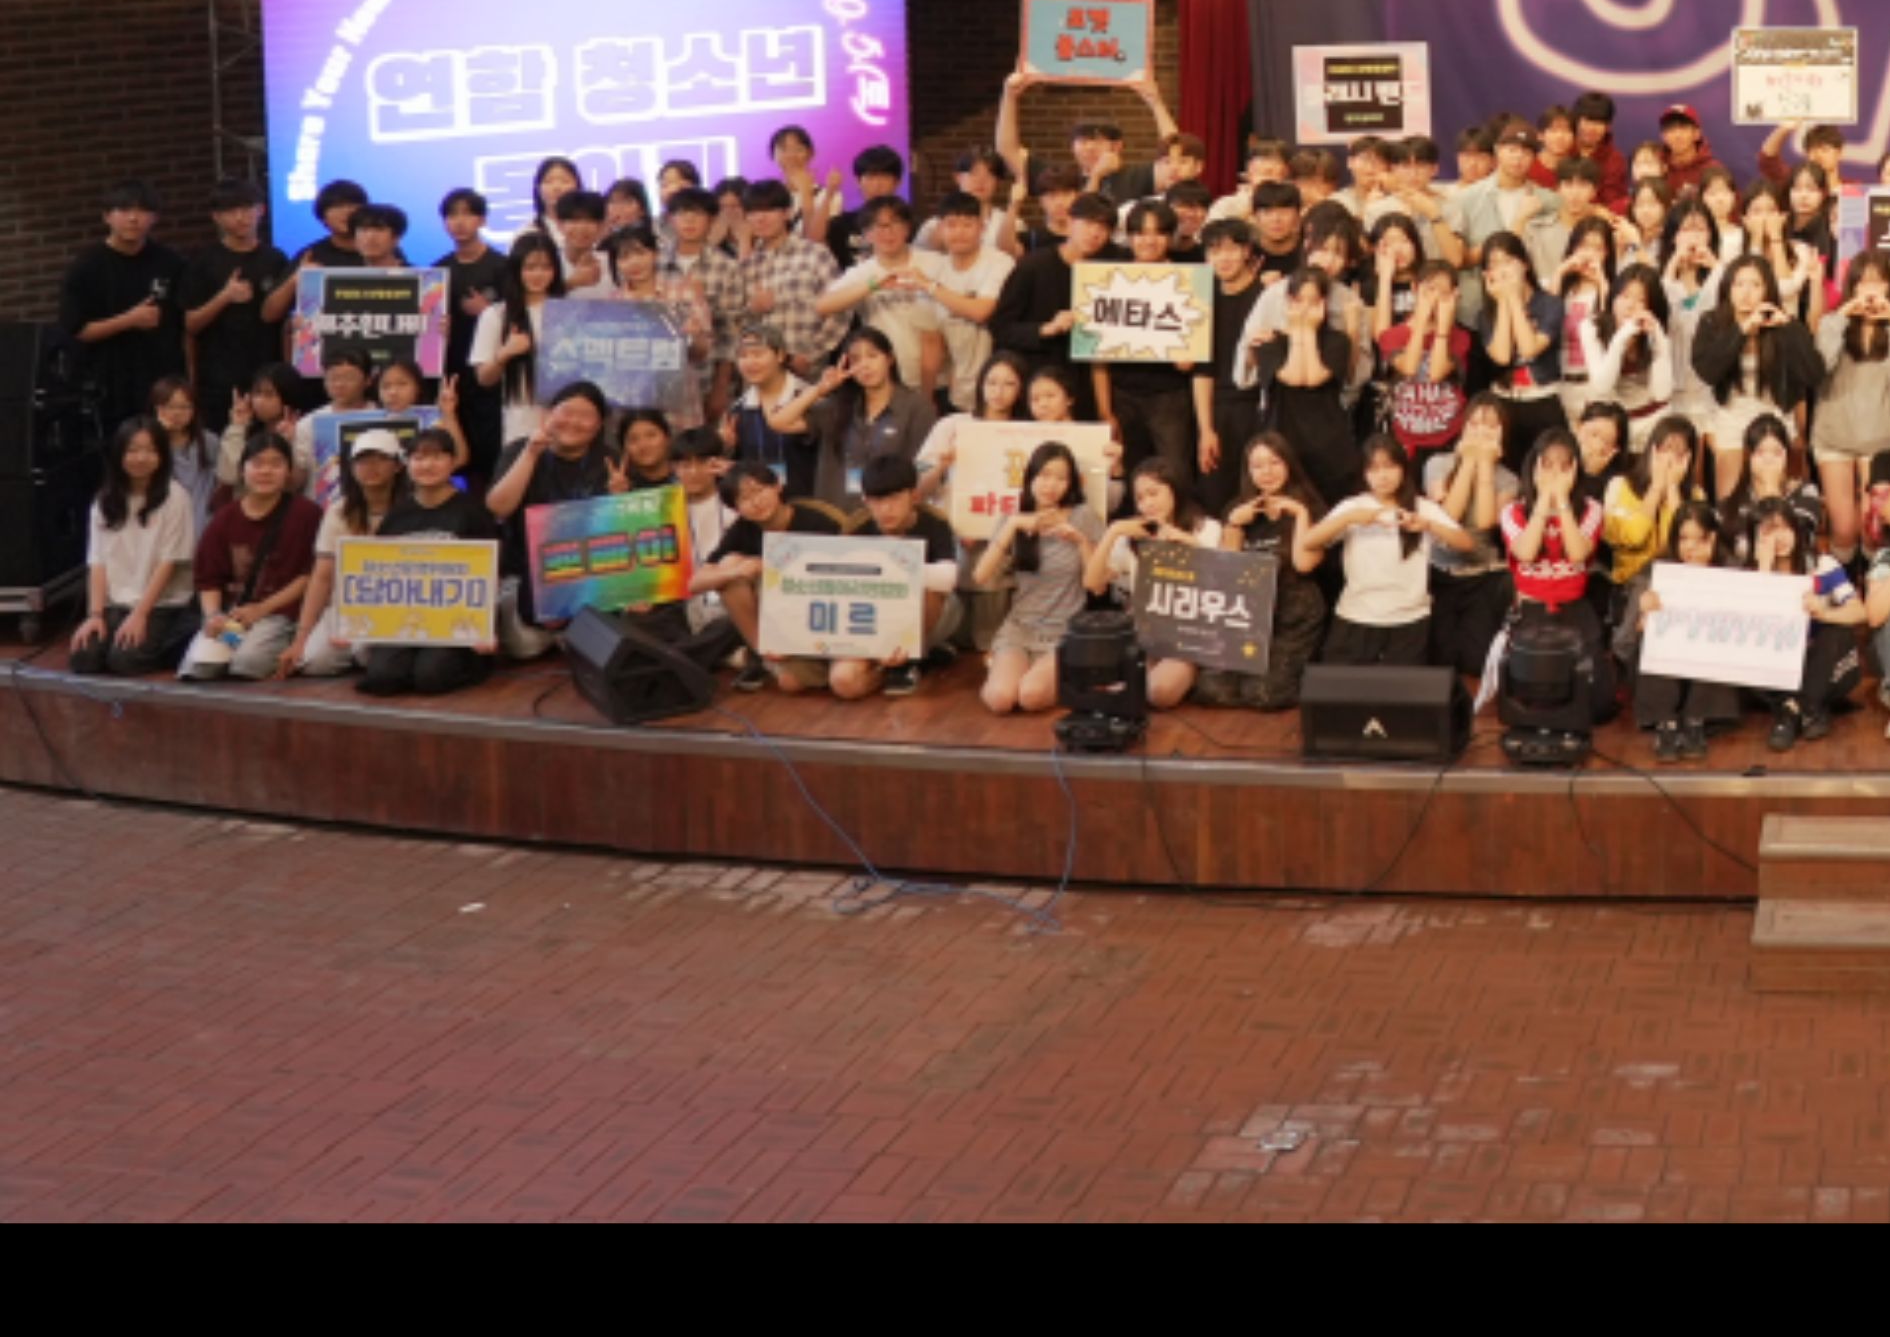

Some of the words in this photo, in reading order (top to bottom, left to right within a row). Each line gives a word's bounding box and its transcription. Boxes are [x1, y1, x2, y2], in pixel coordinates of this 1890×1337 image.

[572, 24, 828, 126] 청소년
[1092, 294, 1184, 332] 에타스
[1144, 581, 1252, 629] 시리우스
